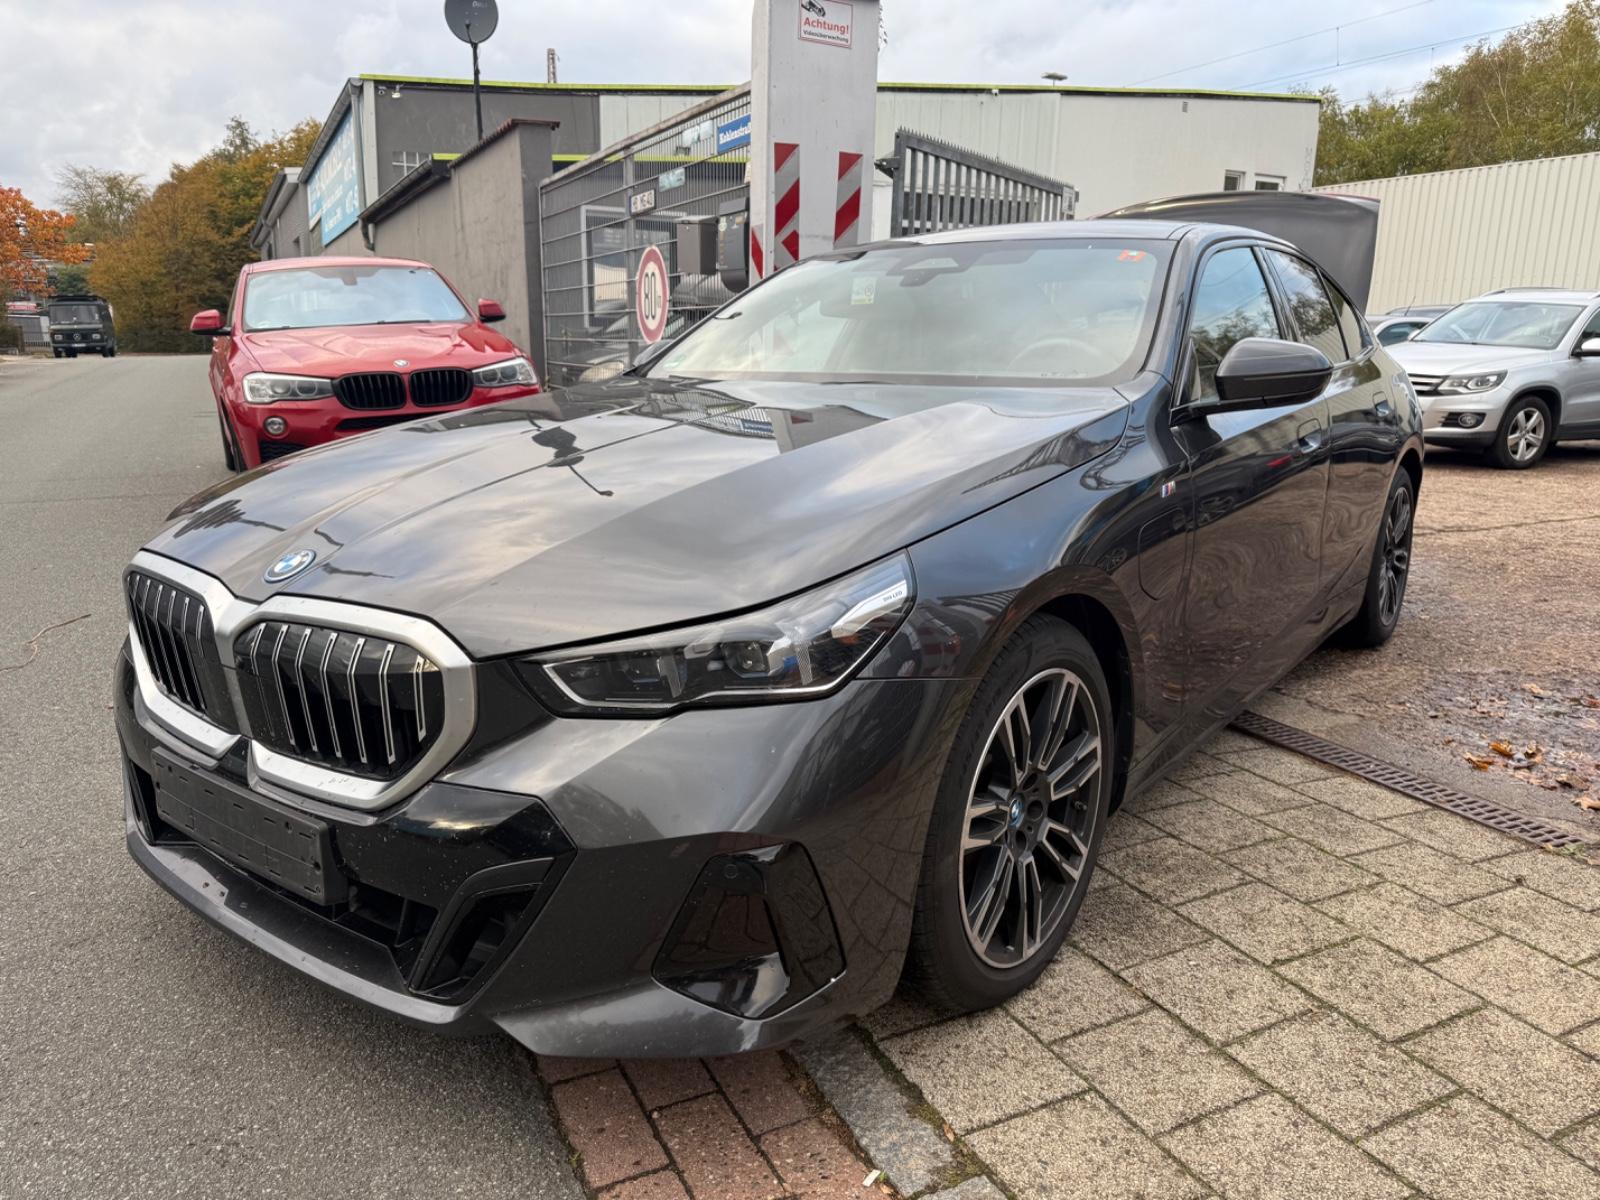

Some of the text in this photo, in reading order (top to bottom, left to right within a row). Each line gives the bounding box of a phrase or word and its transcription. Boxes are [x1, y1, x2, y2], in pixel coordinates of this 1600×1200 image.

[803, 17, 849, 34] Achtung!
[803, 29, 849, 43] Videoüberwachung
[644, 271, 657, 320] 80
